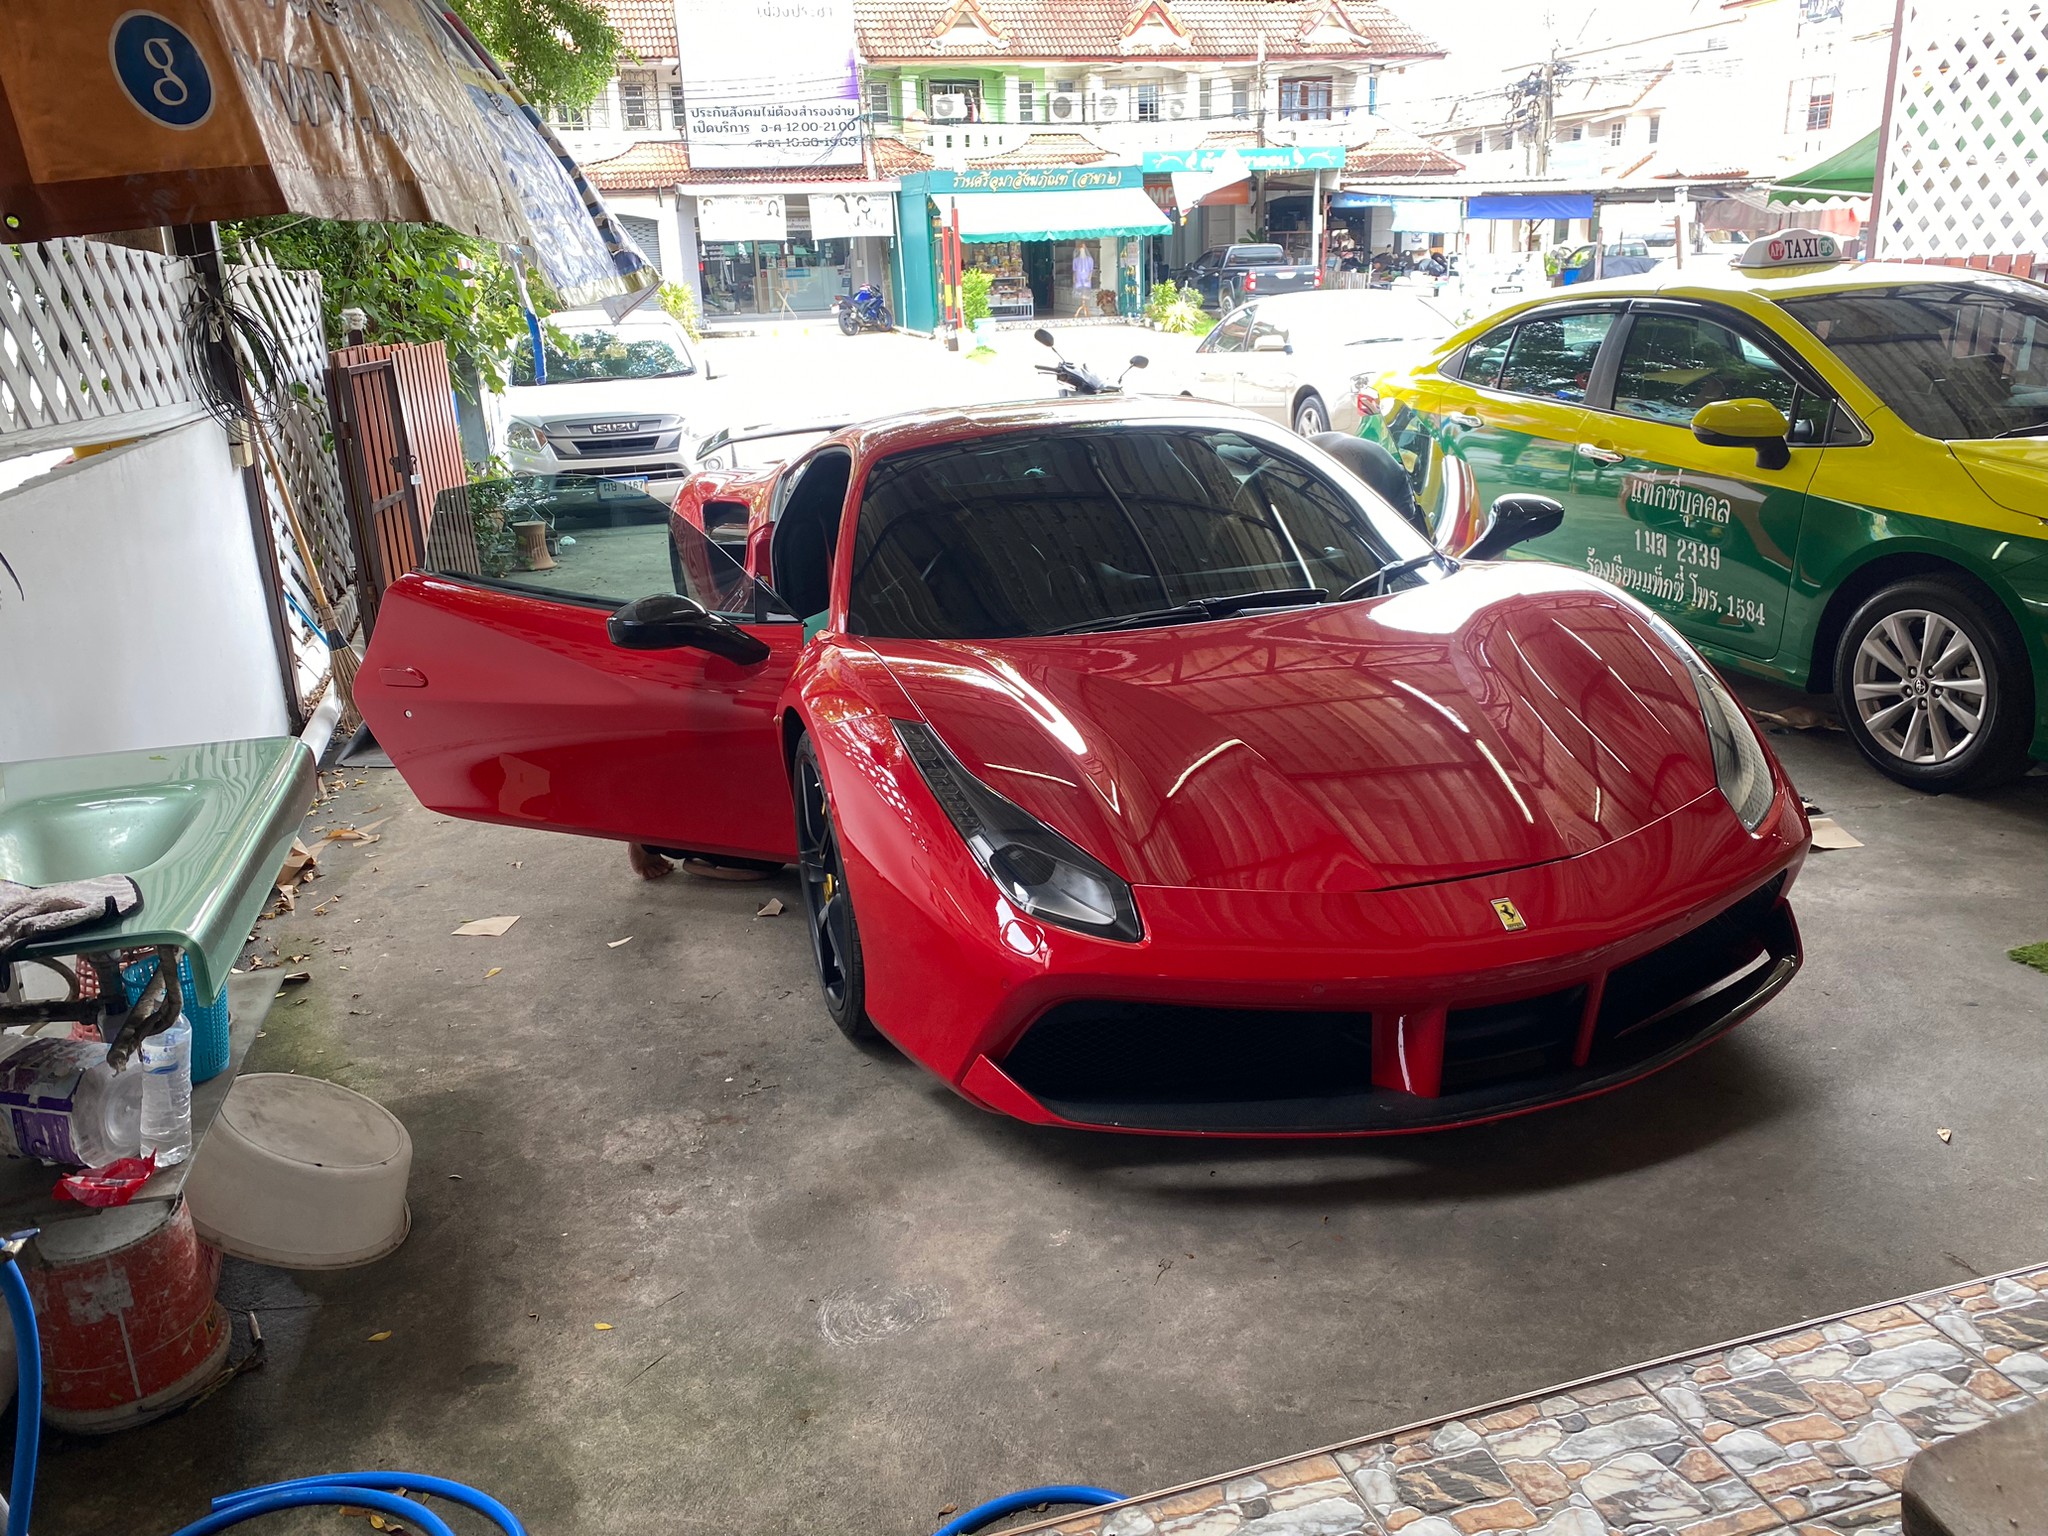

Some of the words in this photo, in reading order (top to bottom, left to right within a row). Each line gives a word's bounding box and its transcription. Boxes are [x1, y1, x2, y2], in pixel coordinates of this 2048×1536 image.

[693, 120, 750, 133] เปิดบริการ
[1770, 243, 1784, 257] APP
[1785, 238, 1819, 259] TAXI
[1820, 239, 1834, 254] GPS
[592, 422, 636, 433] ISUZU
[1631, 469, 1731, 528] แท็กซี่บุคคล
[1677, 539, 1721, 570] 2339
[1586, 547, 1685, 603] ร้องเรียนแท็กซี่
[1689, 573, 1723, 613] โทร.
[1727, 595, 1766, 626] 1584
